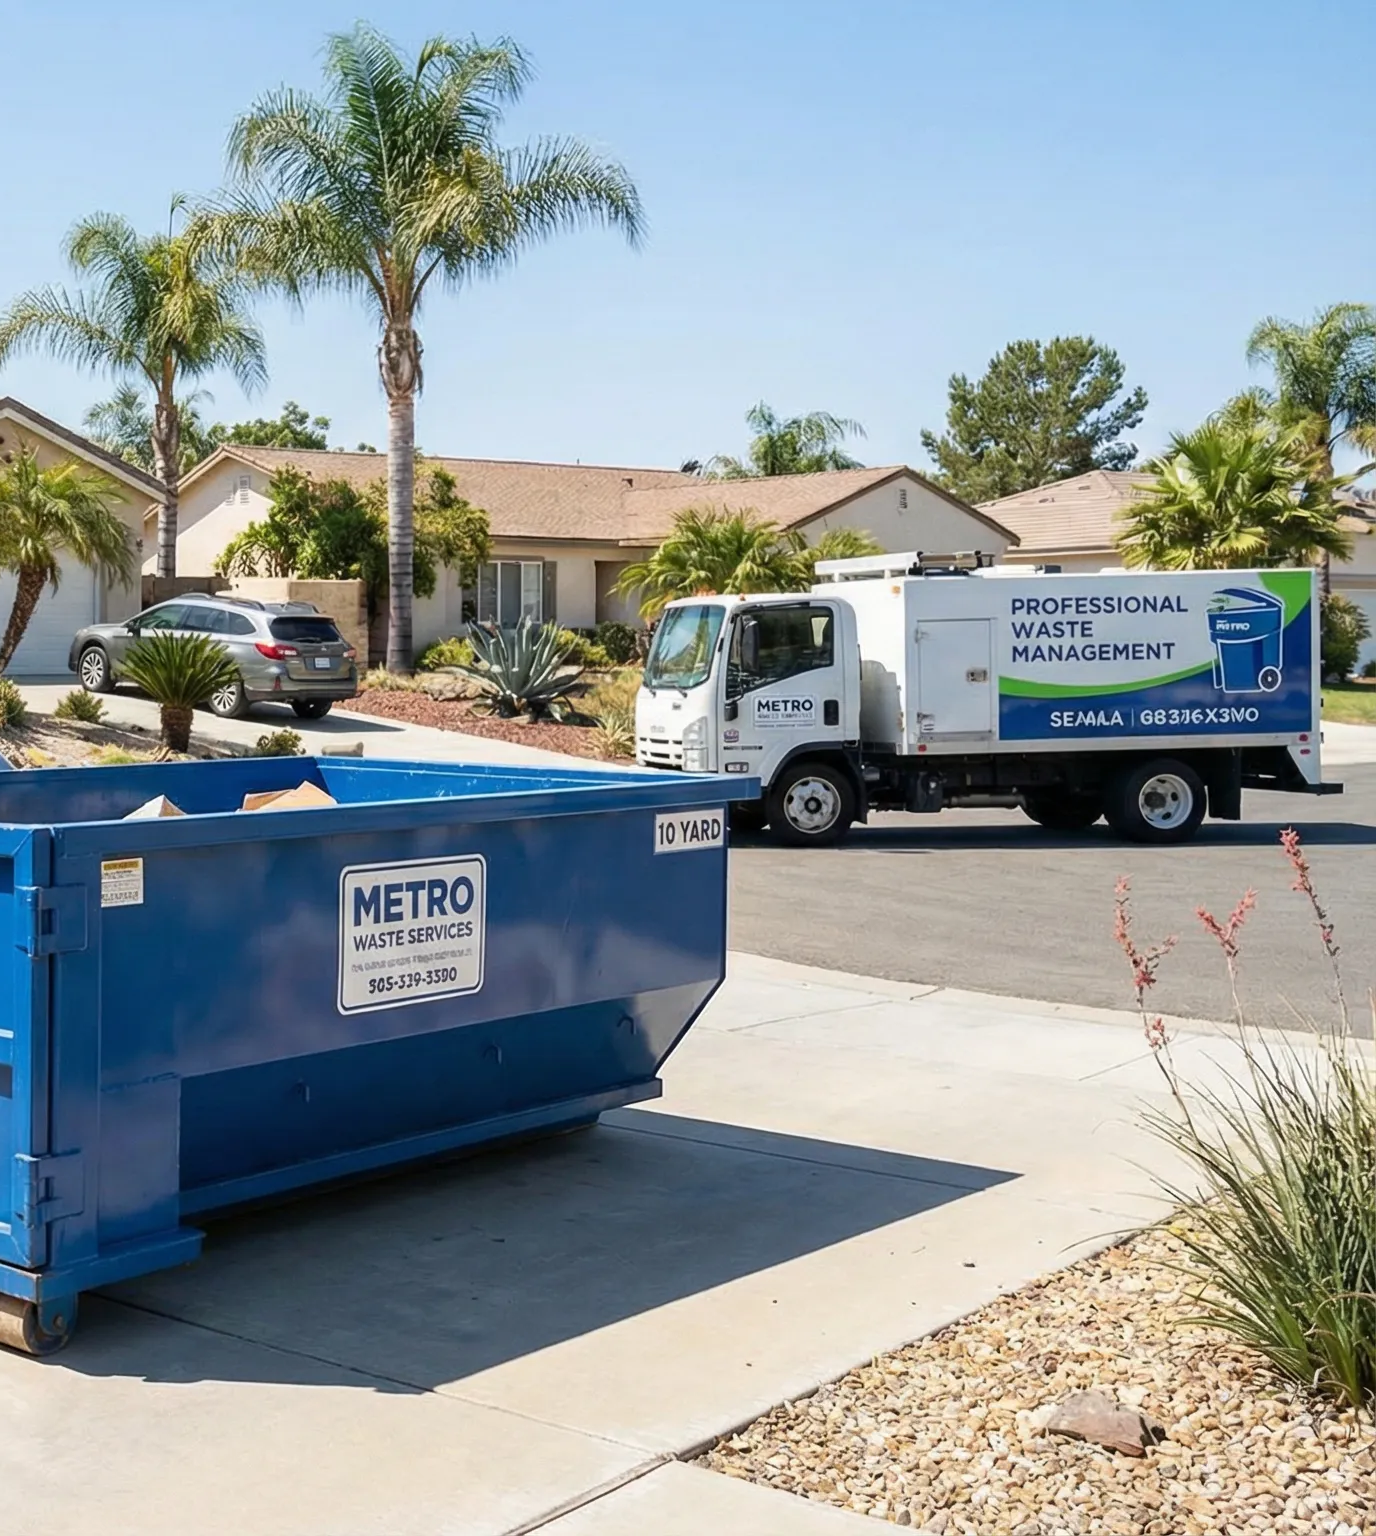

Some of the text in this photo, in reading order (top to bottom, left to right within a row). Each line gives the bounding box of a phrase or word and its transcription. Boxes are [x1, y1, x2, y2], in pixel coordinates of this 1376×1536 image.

[1011, 595, 1189, 615] PROFESSIONAL
[1011, 620, 1094, 639] WASTE
[1012, 642, 1176, 663] MANAGEMENT
[757, 699, 814, 713] METRO
[658, 818, 721, 845] 10 YARD
[353, 875, 474, 927] METRO
[353, 920, 473, 952] WASTE SERVICES
